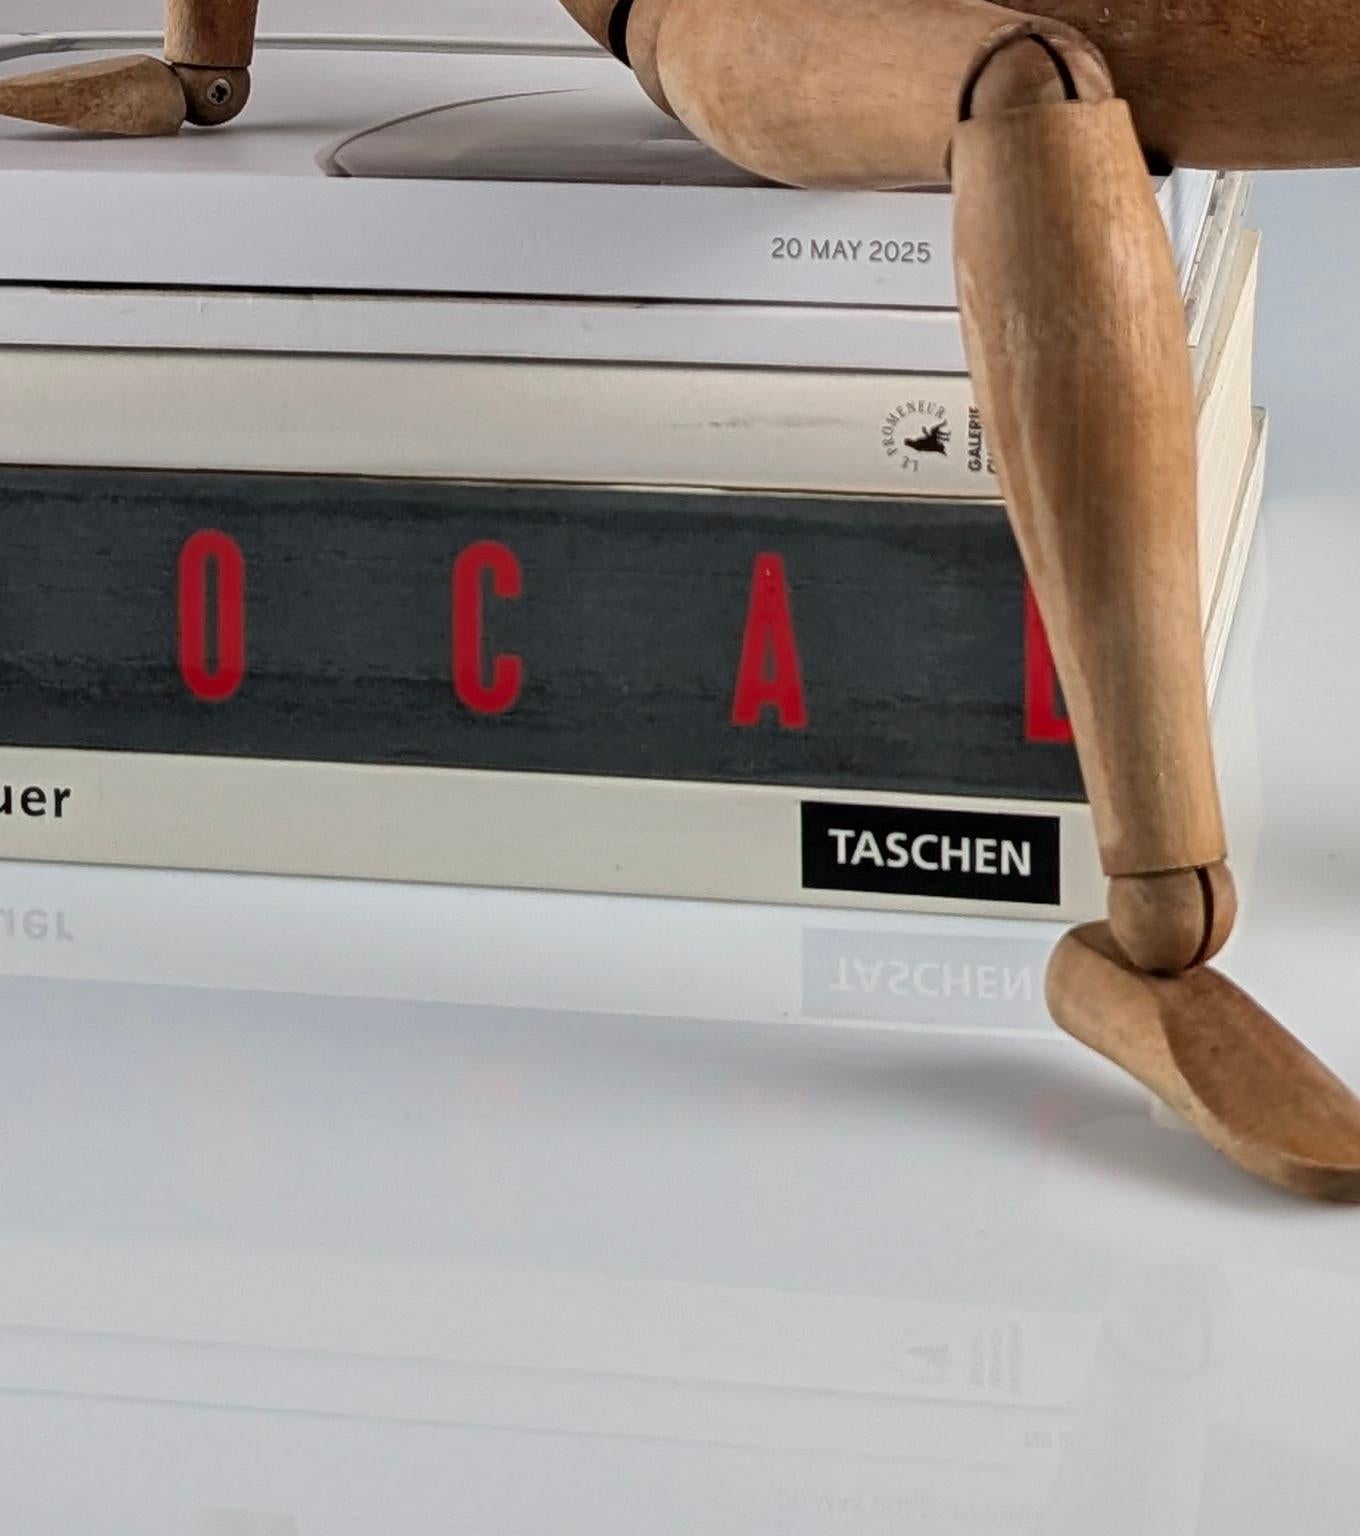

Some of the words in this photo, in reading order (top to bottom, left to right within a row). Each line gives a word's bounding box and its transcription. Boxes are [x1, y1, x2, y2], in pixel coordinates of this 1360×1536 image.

[770, 236, 803, 260] 20
[809, 238, 863, 263] MAY
[868, 239, 932, 265] 2025
[881, 399, 947, 457] PROMENEUR
[827, 827, 1032, 878] TASCHEN
